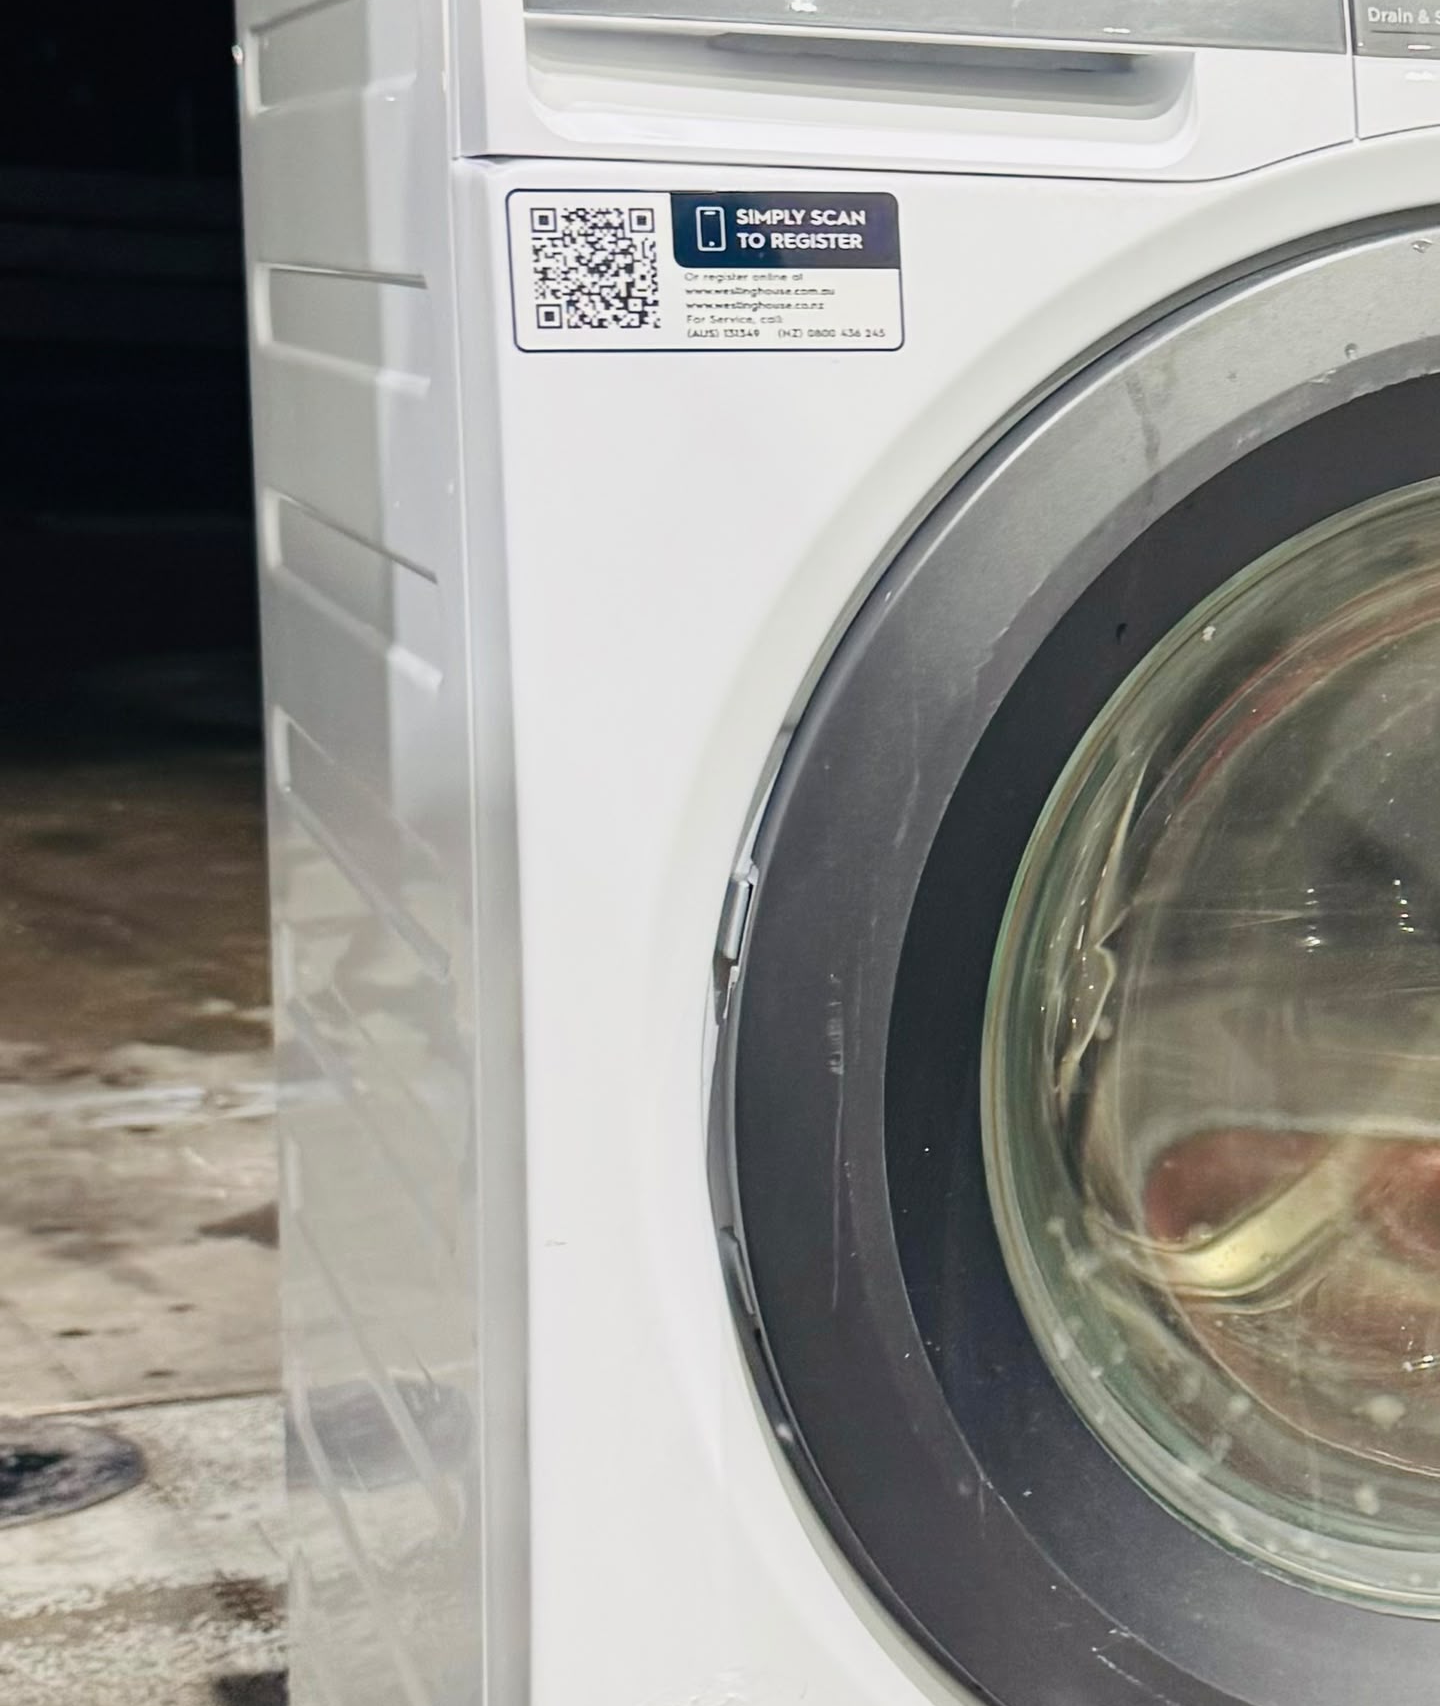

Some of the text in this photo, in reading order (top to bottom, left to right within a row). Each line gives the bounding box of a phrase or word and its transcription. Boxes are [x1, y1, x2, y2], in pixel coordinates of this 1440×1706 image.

[1367, 6, 1414, 23] Drain
[1418, 8, 1430, 24] &
[736, 208, 867, 226] SIMPLY SCAN
[736, 232, 864, 250] TO REGISTER
[684, 272, 699, 282] Or
[703, 272, 748, 284] register
[752, 272, 788, 282] online
[684, 287, 836, 298] www.westinghouse.com.au
[686, 301, 825, 312] www.westinghouse.co.nz
[686, 315, 705, 324] For
[709, 315, 756, 325] Service,
[687, 328, 720, 339] (AUS)
[777, 328, 804, 339] (NZ)
[807, 329, 836, 338] 0800
